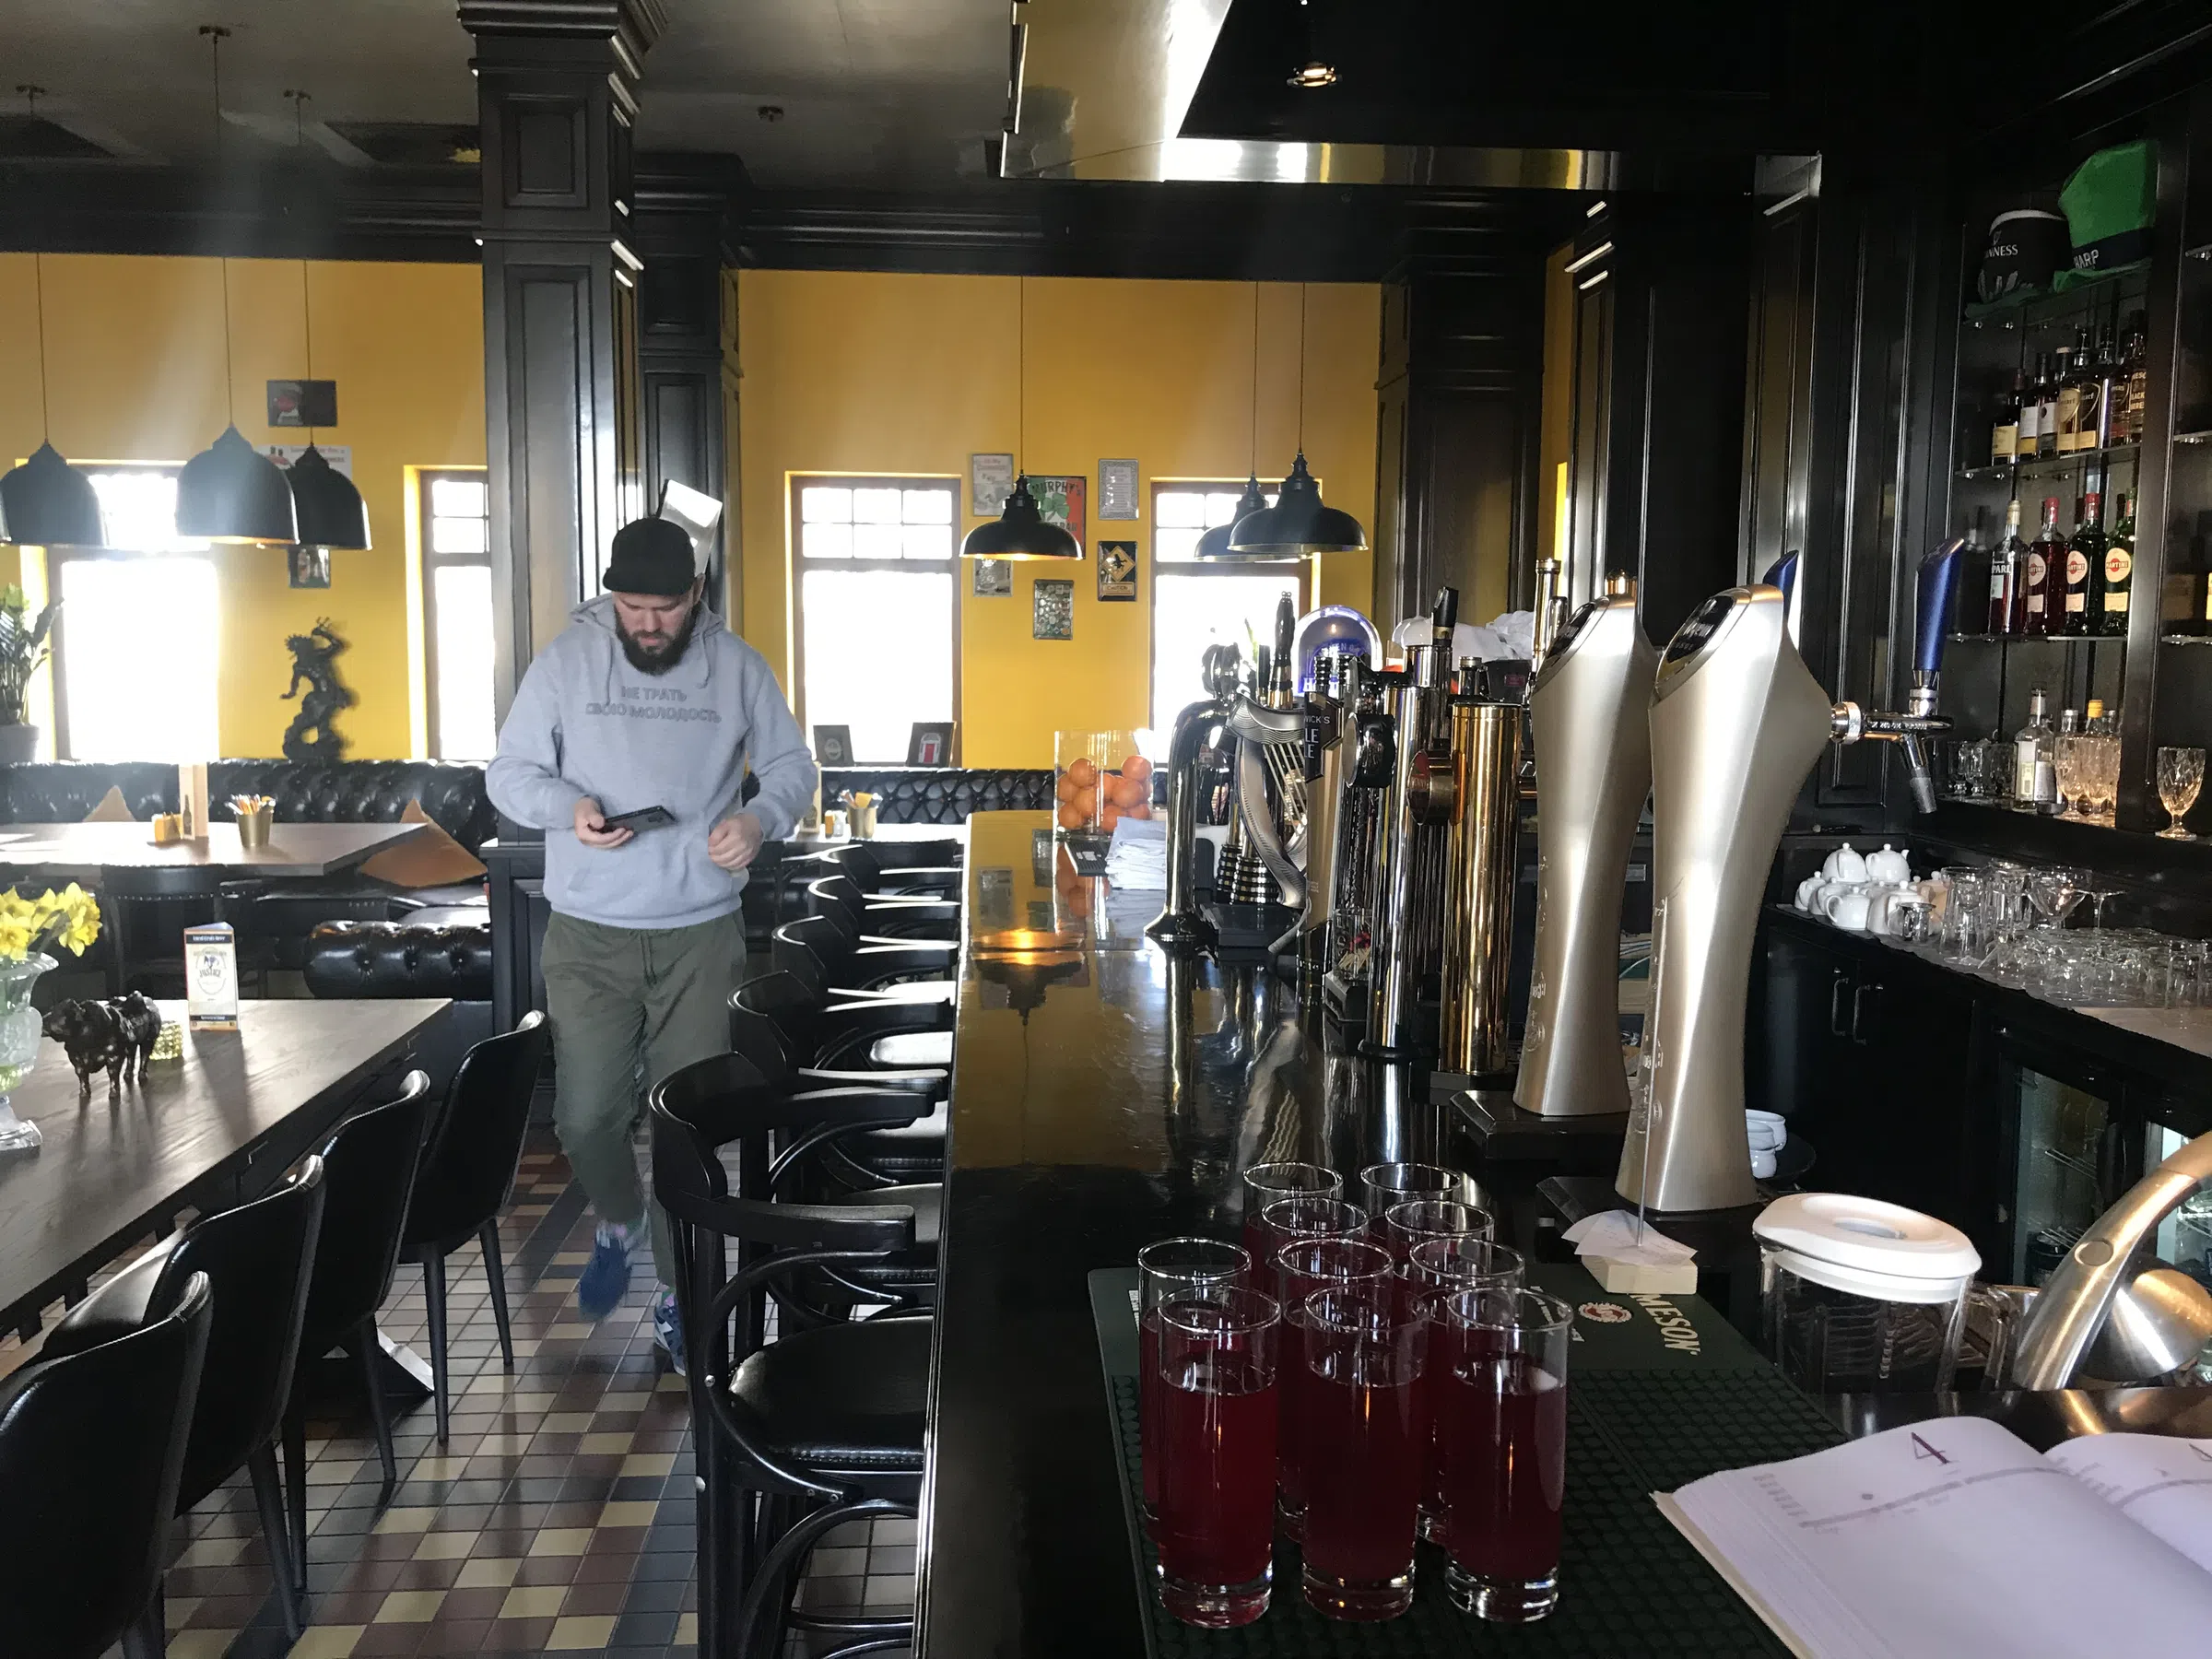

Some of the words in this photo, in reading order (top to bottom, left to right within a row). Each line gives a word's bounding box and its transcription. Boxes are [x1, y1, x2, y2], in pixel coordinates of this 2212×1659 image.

[1992, 565, 2011, 573] PARI
[2105, 561, 2129, 570] MARTINI
[621, 686, 640, 700] НЕ
[642, 687, 687, 701] ТРАТЬ
[585, 702, 626, 716] СВОЮ
[629, 705, 722, 724] МОЛОДОСТЬ
[1630, 1294, 1701, 1352] MESON
